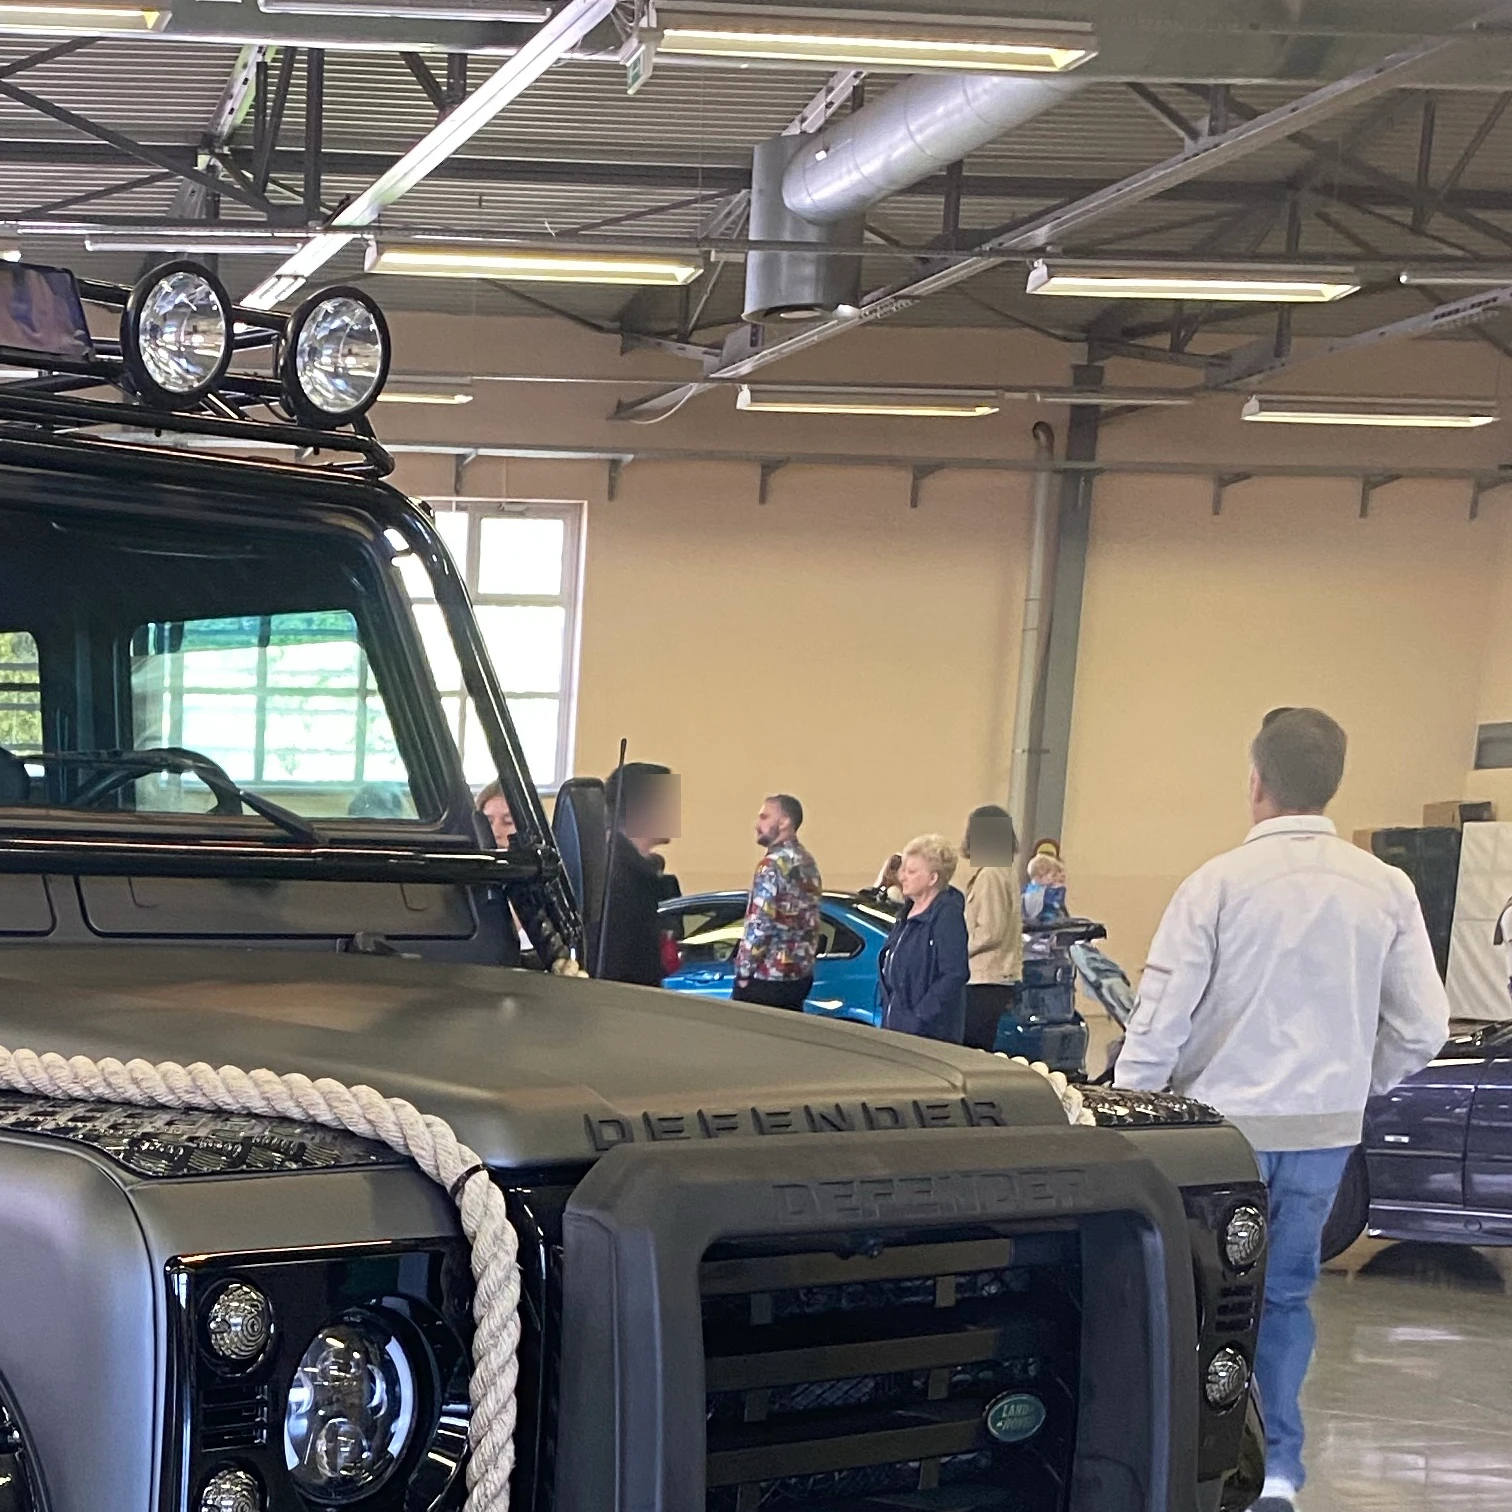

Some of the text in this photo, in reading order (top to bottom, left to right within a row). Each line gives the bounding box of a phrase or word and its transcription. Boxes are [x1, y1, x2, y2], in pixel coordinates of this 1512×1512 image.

[583, 1097, 1007, 1152] DEFENDER
[772, 1168, 1093, 1219] DEFENDER
[1001, 1418, 1035, 1431] ROVE
[1002, 1404, 1030, 1417] LAND
